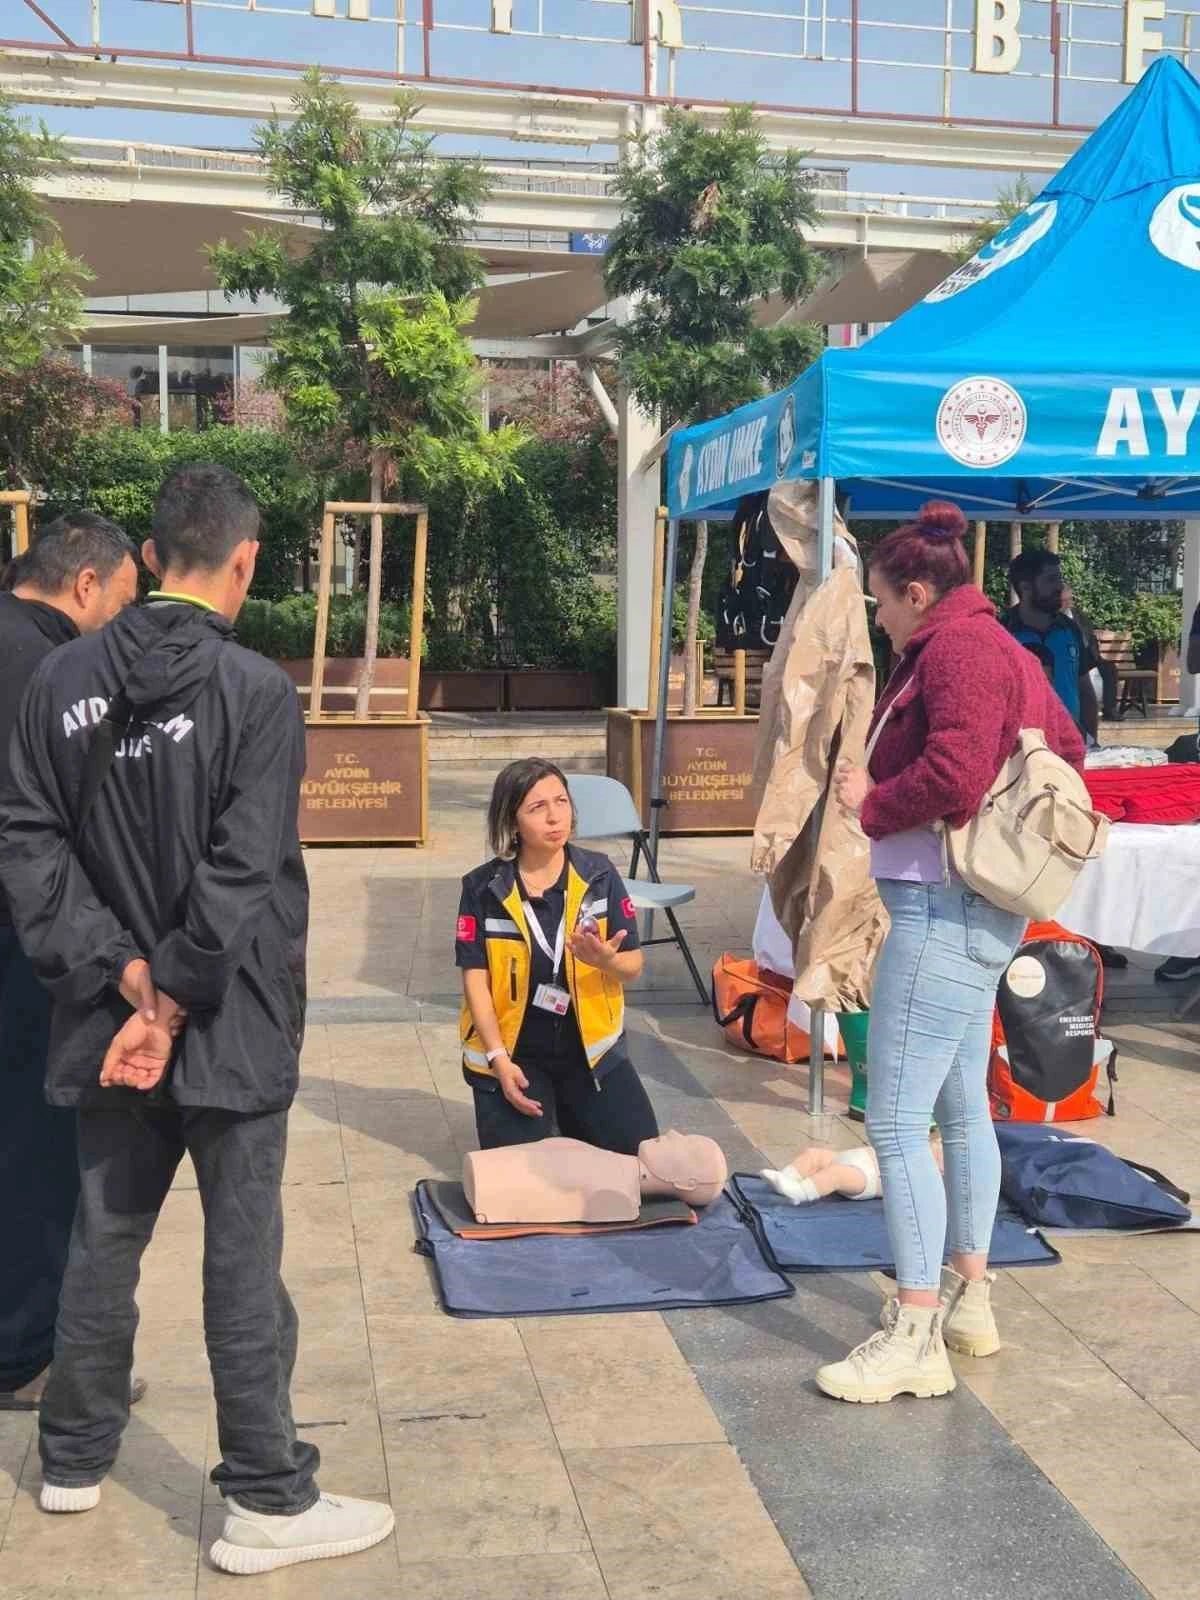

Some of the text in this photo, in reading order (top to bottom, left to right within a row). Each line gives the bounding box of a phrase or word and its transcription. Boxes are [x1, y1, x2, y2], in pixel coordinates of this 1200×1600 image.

[1096, 387, 1200, 456] AY
[696, 433, 731, 497] AYDIN
[687, 759, 728, 771] AYDIN
[323, 767, 370, 778] AYDIN
[300, 780, 401, 797] ÜYÜKŞEHİR
[1065, 1029, 1095, 1037] RESPONS
